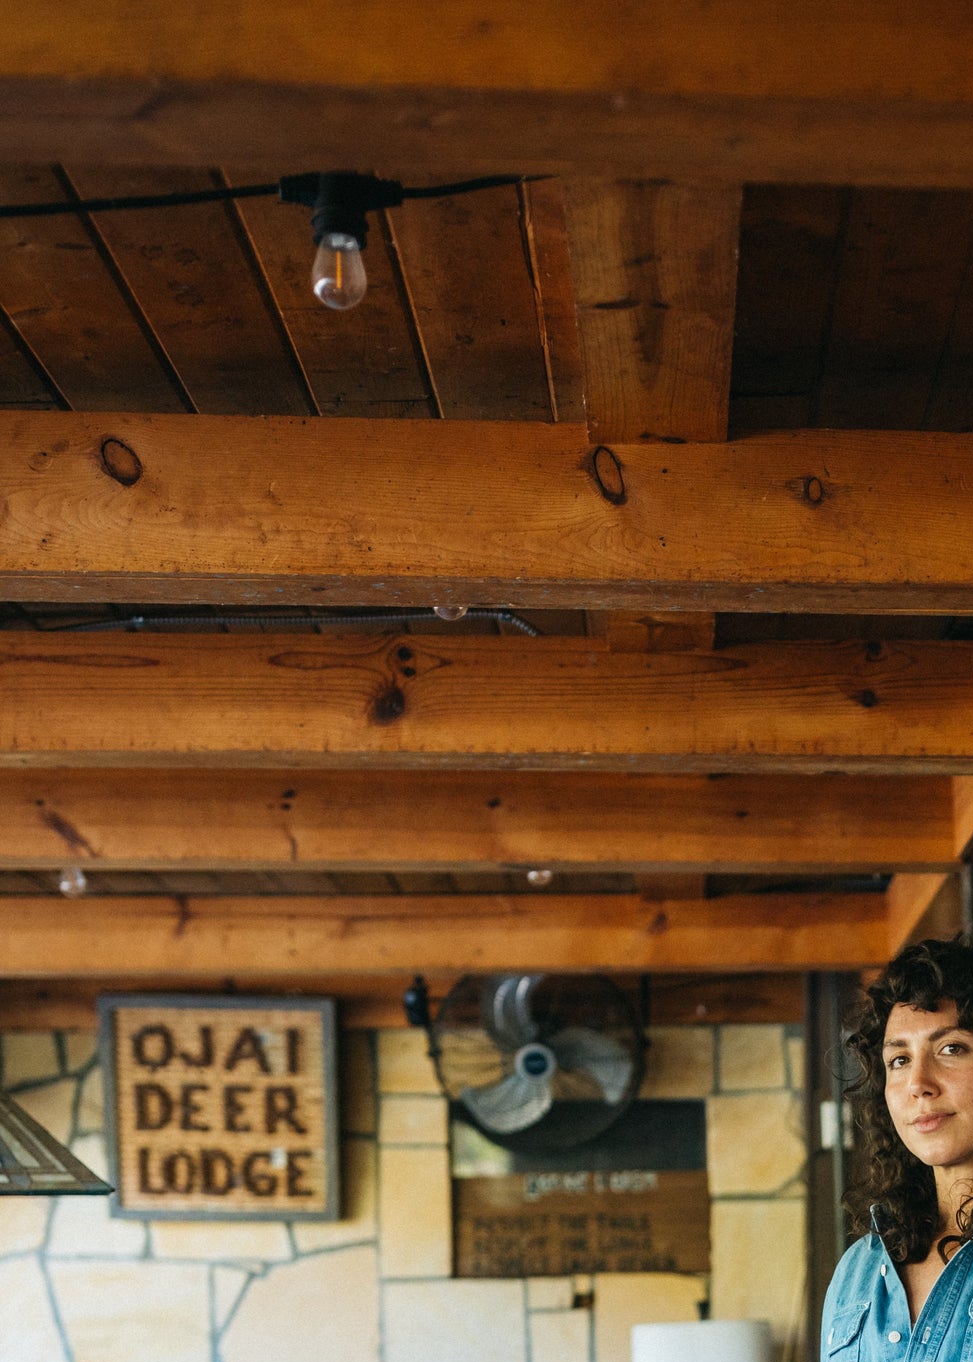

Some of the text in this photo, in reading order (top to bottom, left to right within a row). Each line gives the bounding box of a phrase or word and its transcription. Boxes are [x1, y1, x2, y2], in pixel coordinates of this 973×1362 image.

[132, 1024, 301, 1074] OJAI
[134, 1083, 307, 1134] DEER
[138, 1147, 313, 1197] LODGE
